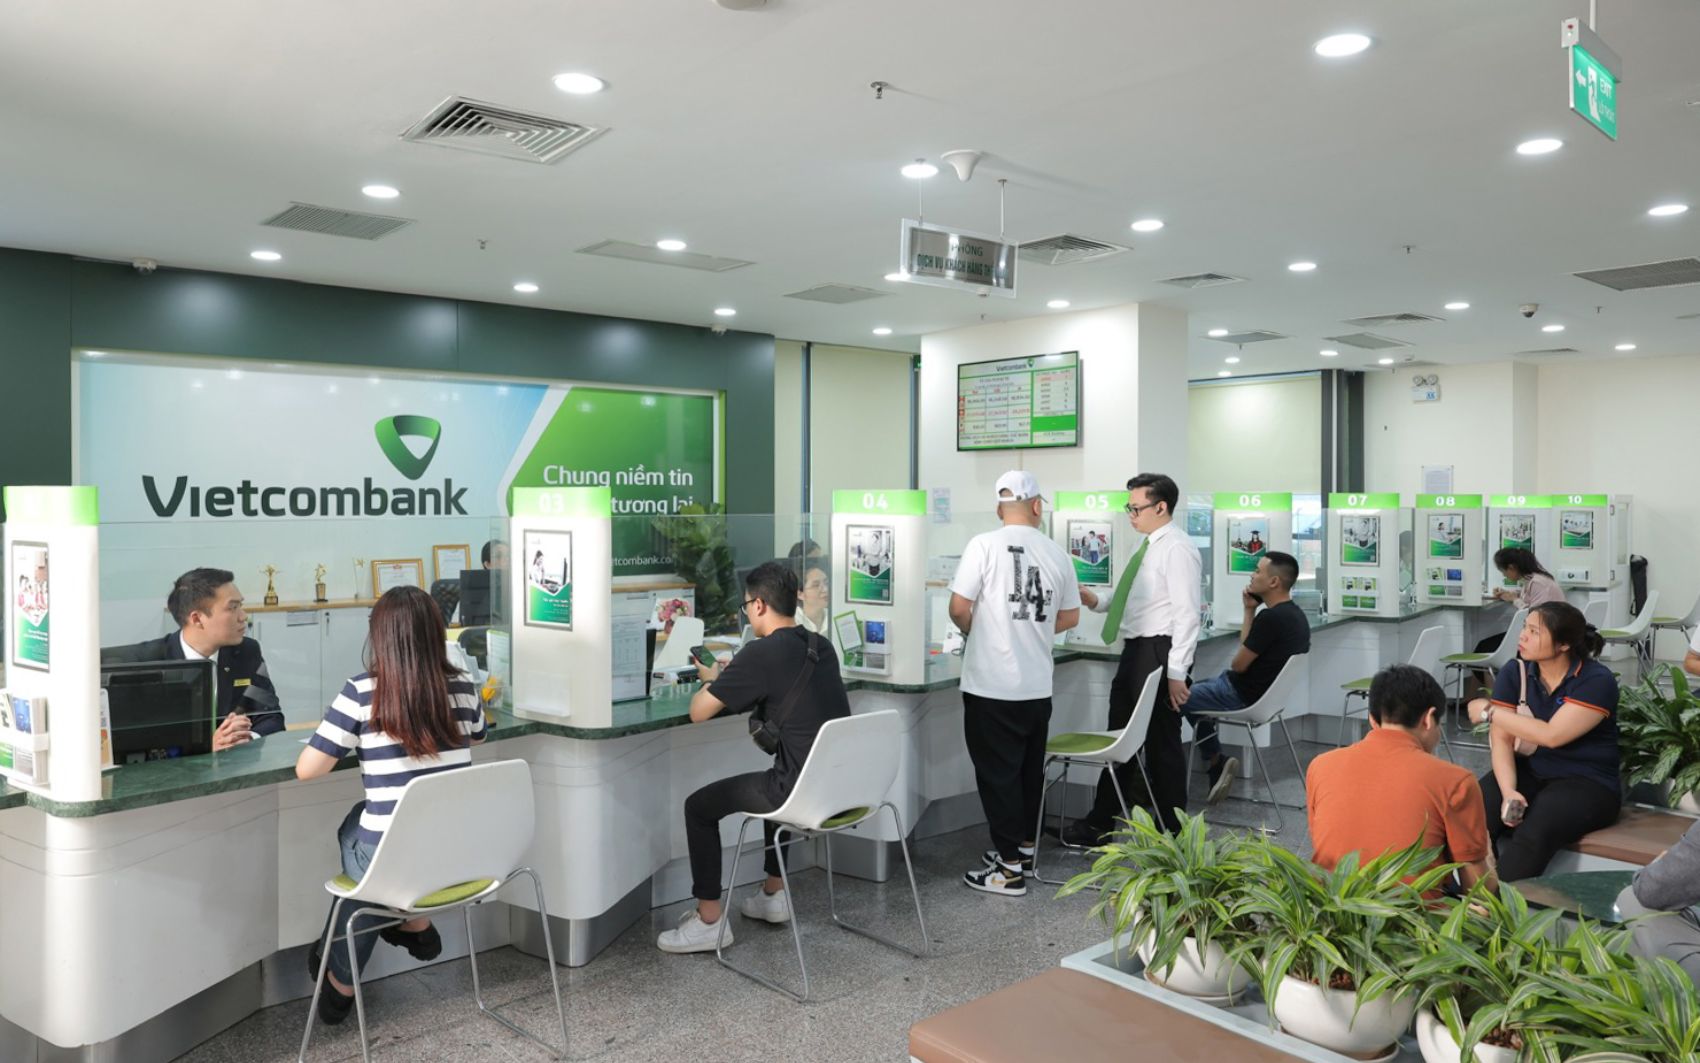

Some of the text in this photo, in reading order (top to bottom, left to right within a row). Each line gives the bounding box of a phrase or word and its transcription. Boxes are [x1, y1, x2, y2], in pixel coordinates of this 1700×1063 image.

[543, 464, 693, 487] Chung niềm tin
[142, 475, 469, 517] Vietcombank
[862, 493, 888, 509] 04
[1085, 494, 1109, 509] 05
[1239, 495, 1262, 507] 06
[1348, 495, 1368, 506] 07
[1436, 496, 1456, 507] 08
[1507, 496, 1526, 505] 09
[1568, 495, 1583, 505] 10
[538, 494, 565, 513] 03
